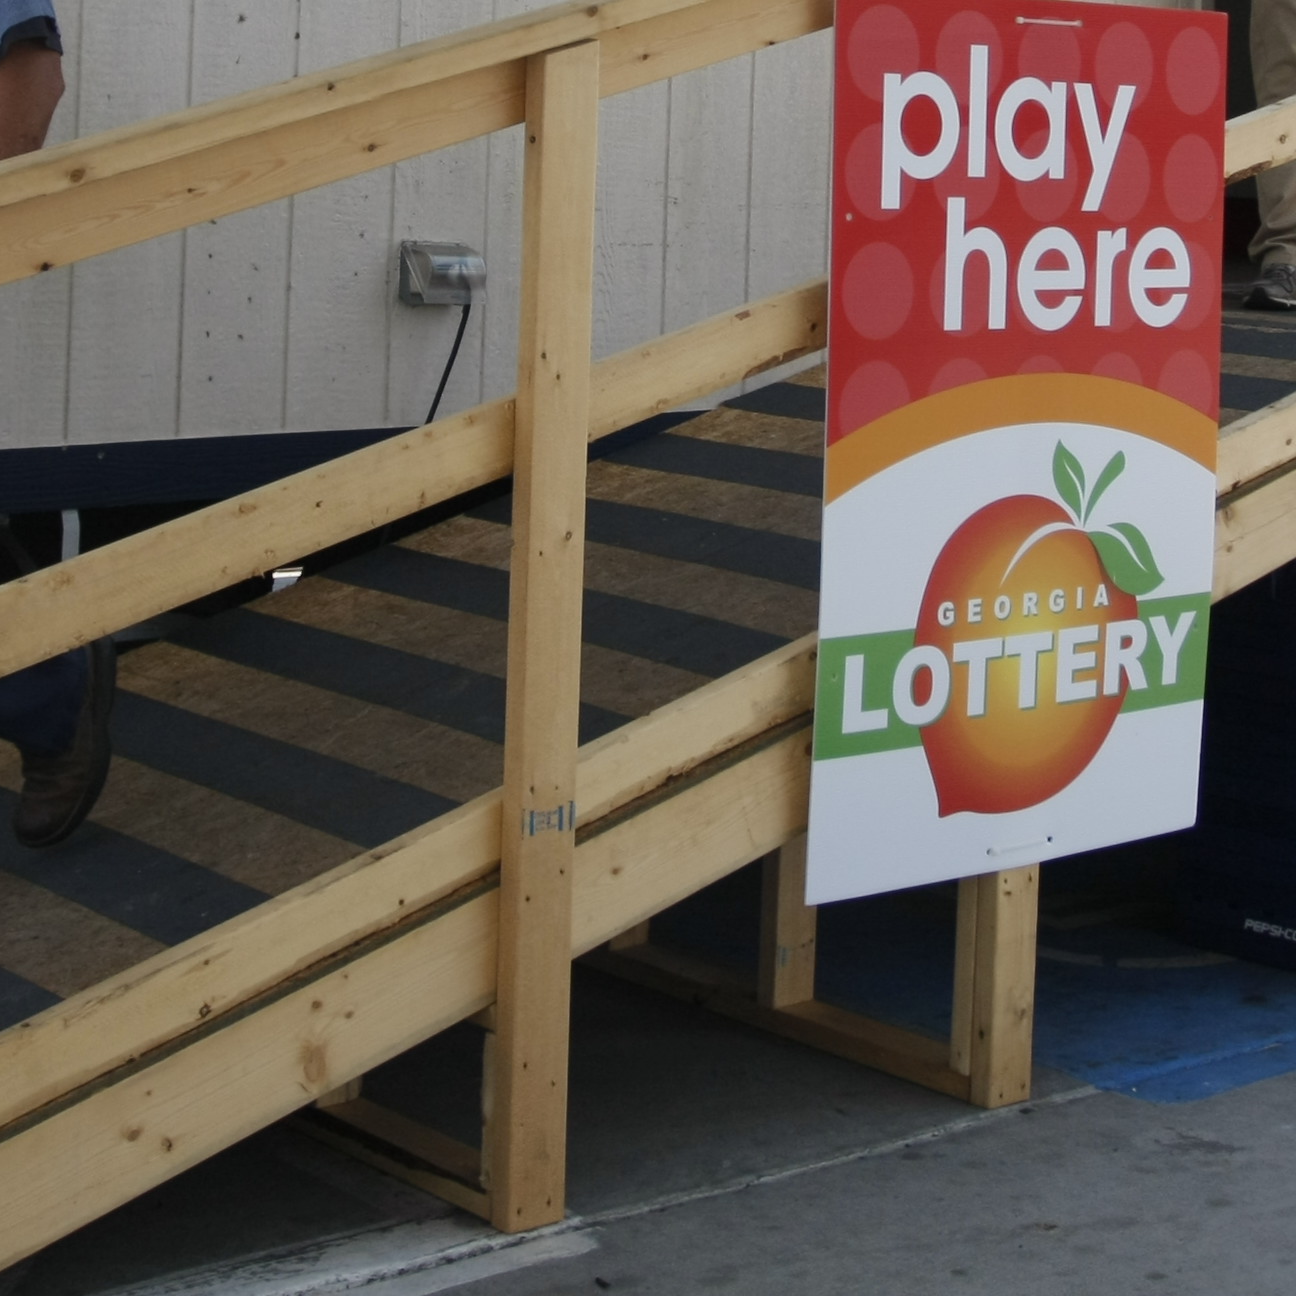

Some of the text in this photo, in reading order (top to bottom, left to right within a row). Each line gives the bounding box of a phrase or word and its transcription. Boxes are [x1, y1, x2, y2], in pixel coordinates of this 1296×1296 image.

[881, 44, 1137, 212] play
[943, 195, 1192, 333] here
[936, 583, 1111, 626] GEORGIA
[841, 610, 1197, 735] LOTTERY
